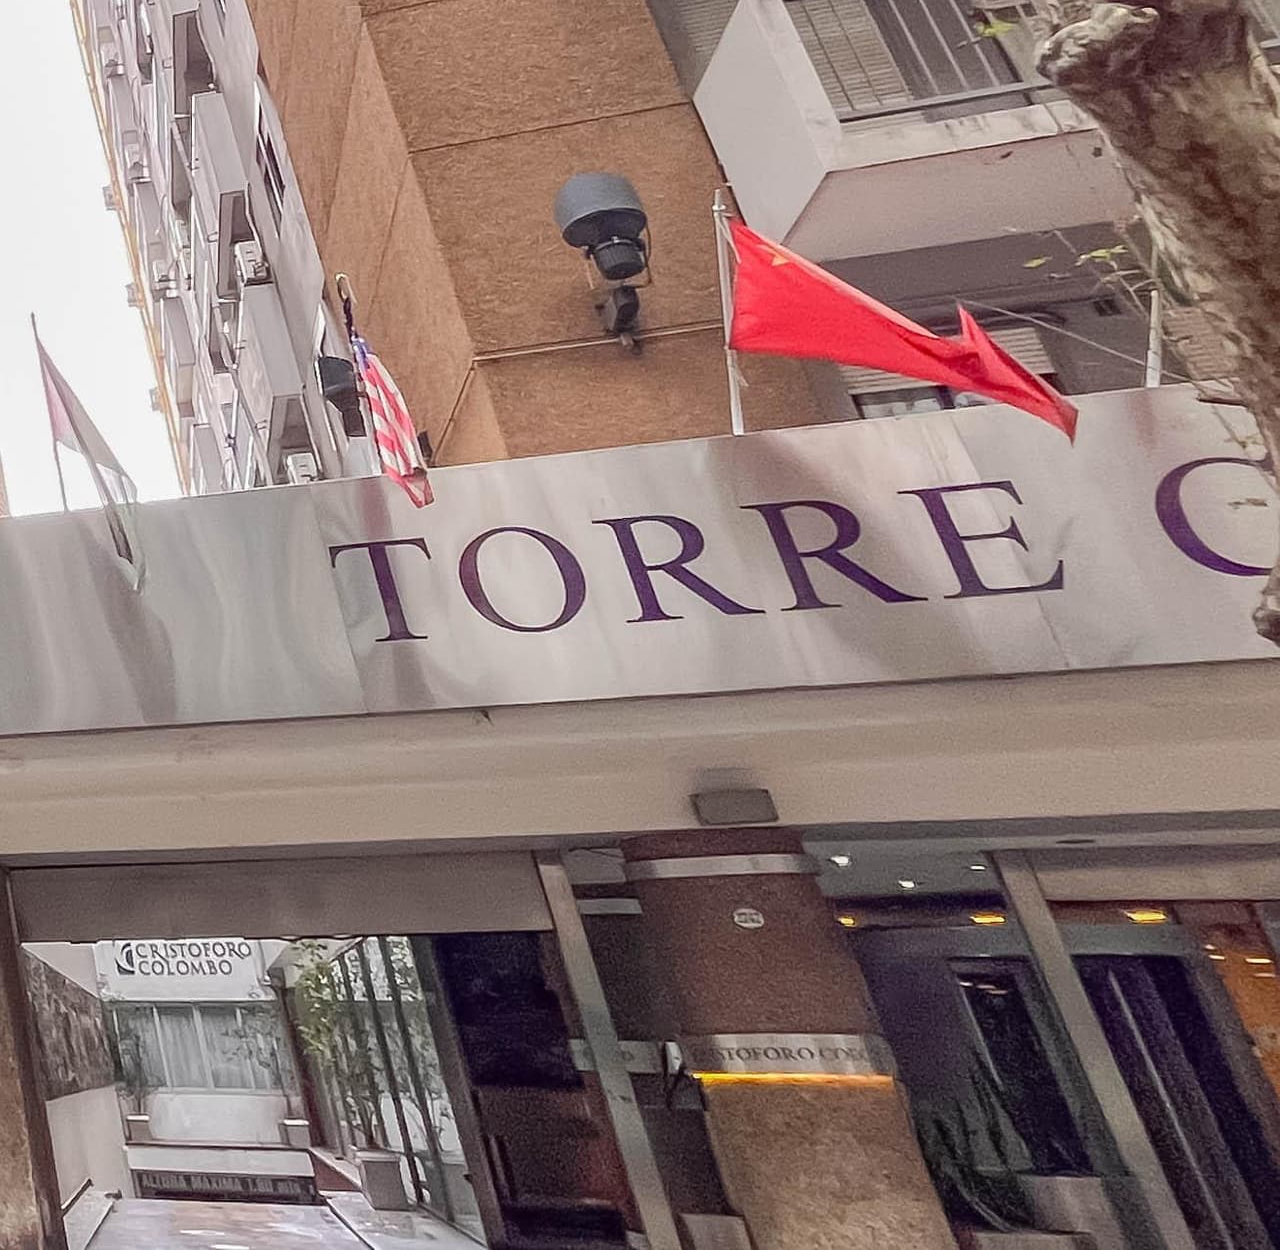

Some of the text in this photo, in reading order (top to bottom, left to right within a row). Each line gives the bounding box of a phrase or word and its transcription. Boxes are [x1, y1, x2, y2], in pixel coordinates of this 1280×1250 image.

[328, 479, 1064, 642] TORRE
[135, 941, 253, 960] CRISTOFORO
[138, 959, 233, 976] COLOMBO
